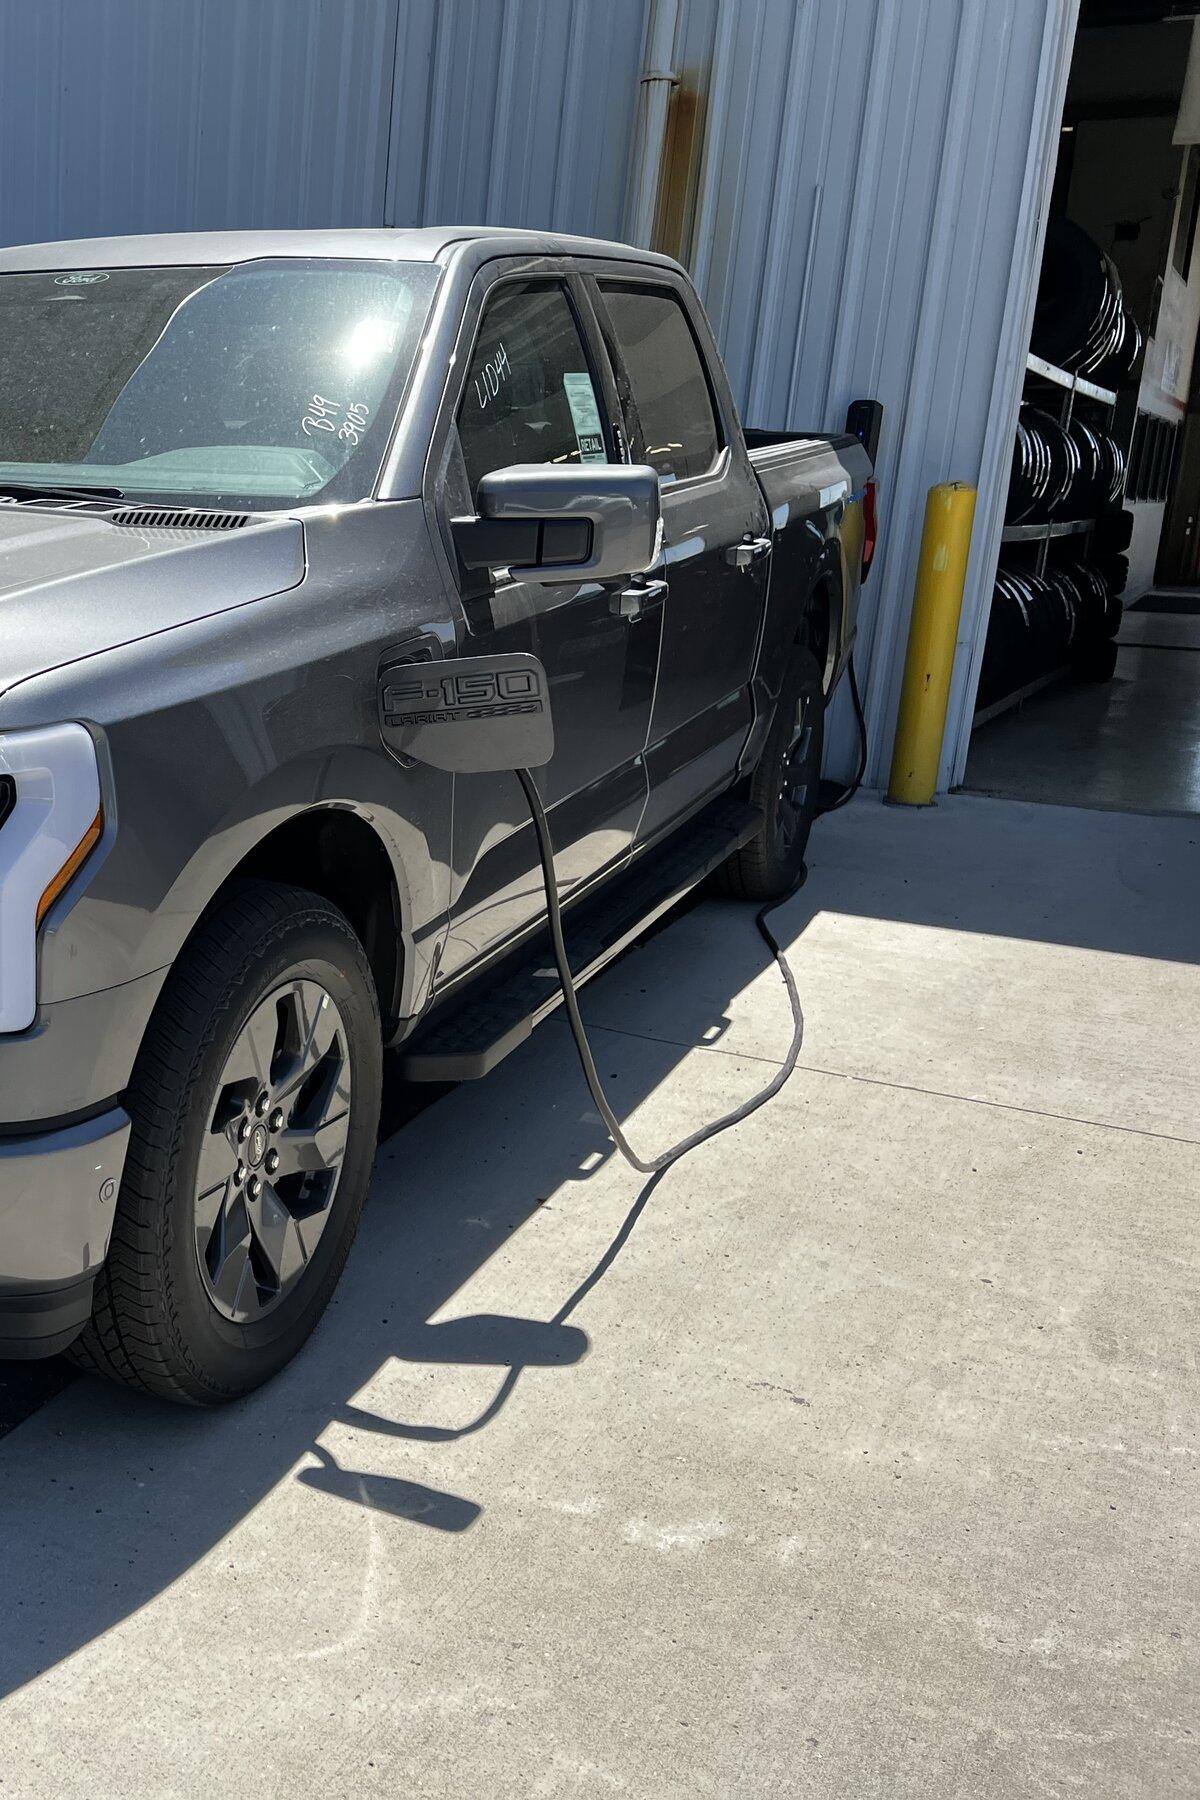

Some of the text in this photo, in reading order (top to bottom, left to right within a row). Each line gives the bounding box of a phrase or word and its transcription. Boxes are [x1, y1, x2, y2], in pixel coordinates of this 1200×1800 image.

[301, 394, 341, 436] B49
[338, 402, 370, 446] 3905
[382, 668, 541, 712] F-150
